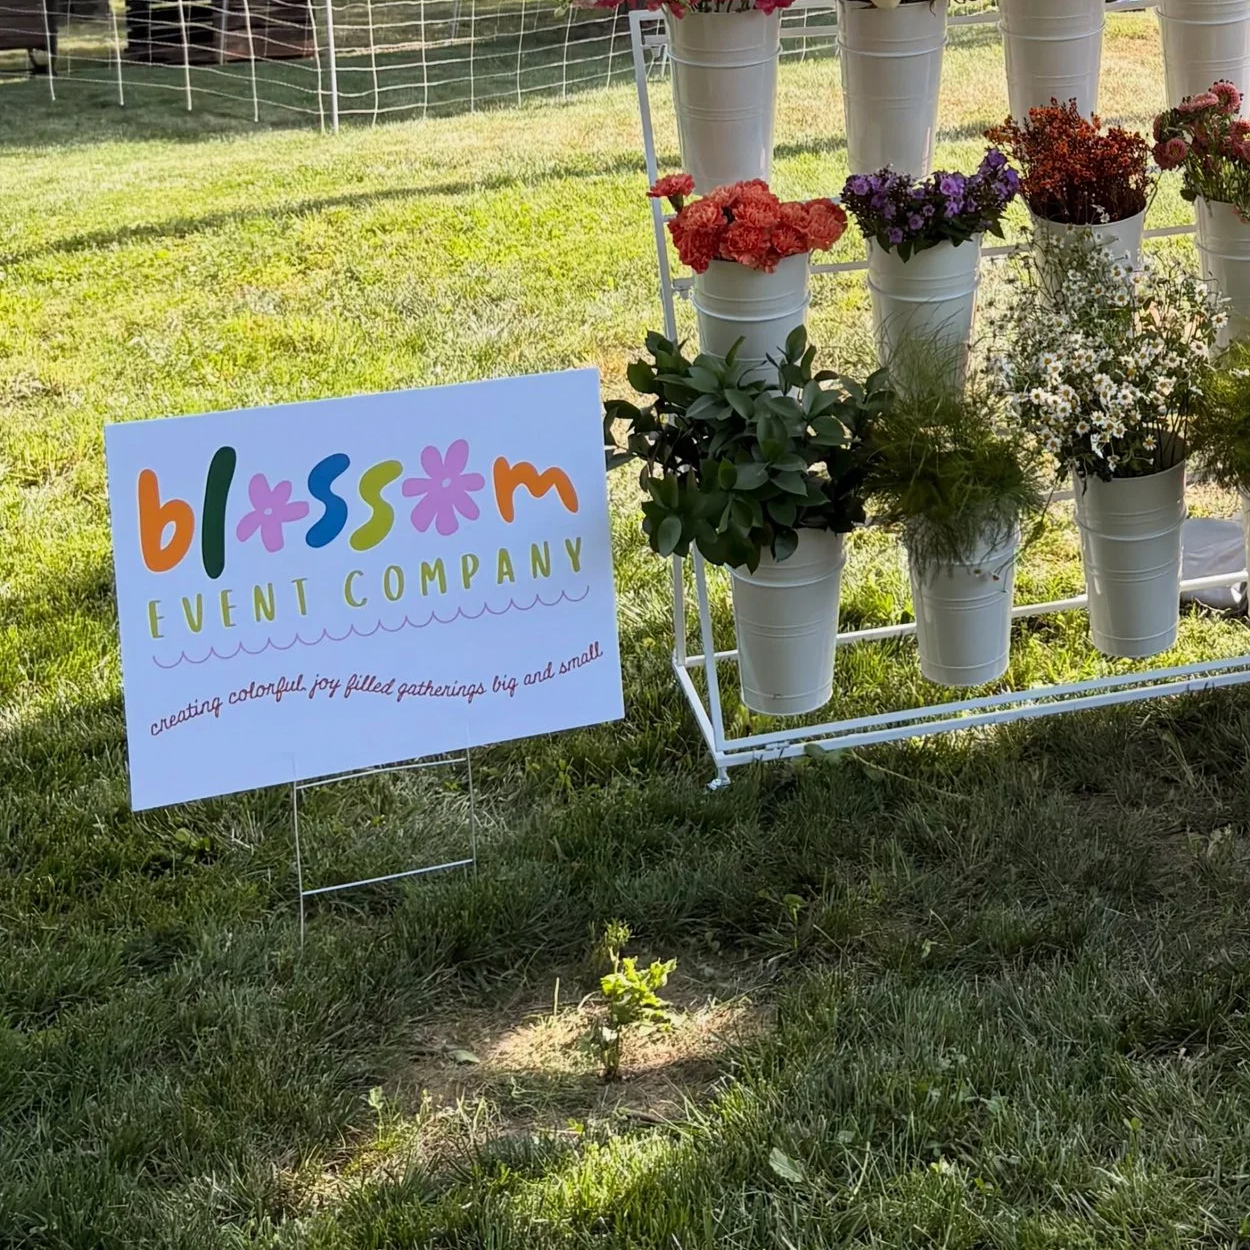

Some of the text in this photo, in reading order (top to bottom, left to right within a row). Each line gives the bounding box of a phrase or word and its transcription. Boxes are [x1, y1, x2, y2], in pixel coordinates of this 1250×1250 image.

[137, 438, 580, 579] blossom
[148, 536, 584, 639] EVENT COMPANY
[150, 695, 223, 736] creating
[308, 673, 342, 699] joy
[344, 673, 396, 699] filled
[397, 679, 486, 703] gatherings
[492, 673, 518, 696] big
[523, 664, 555, 687] and
[558, 641, 604, 676] small
